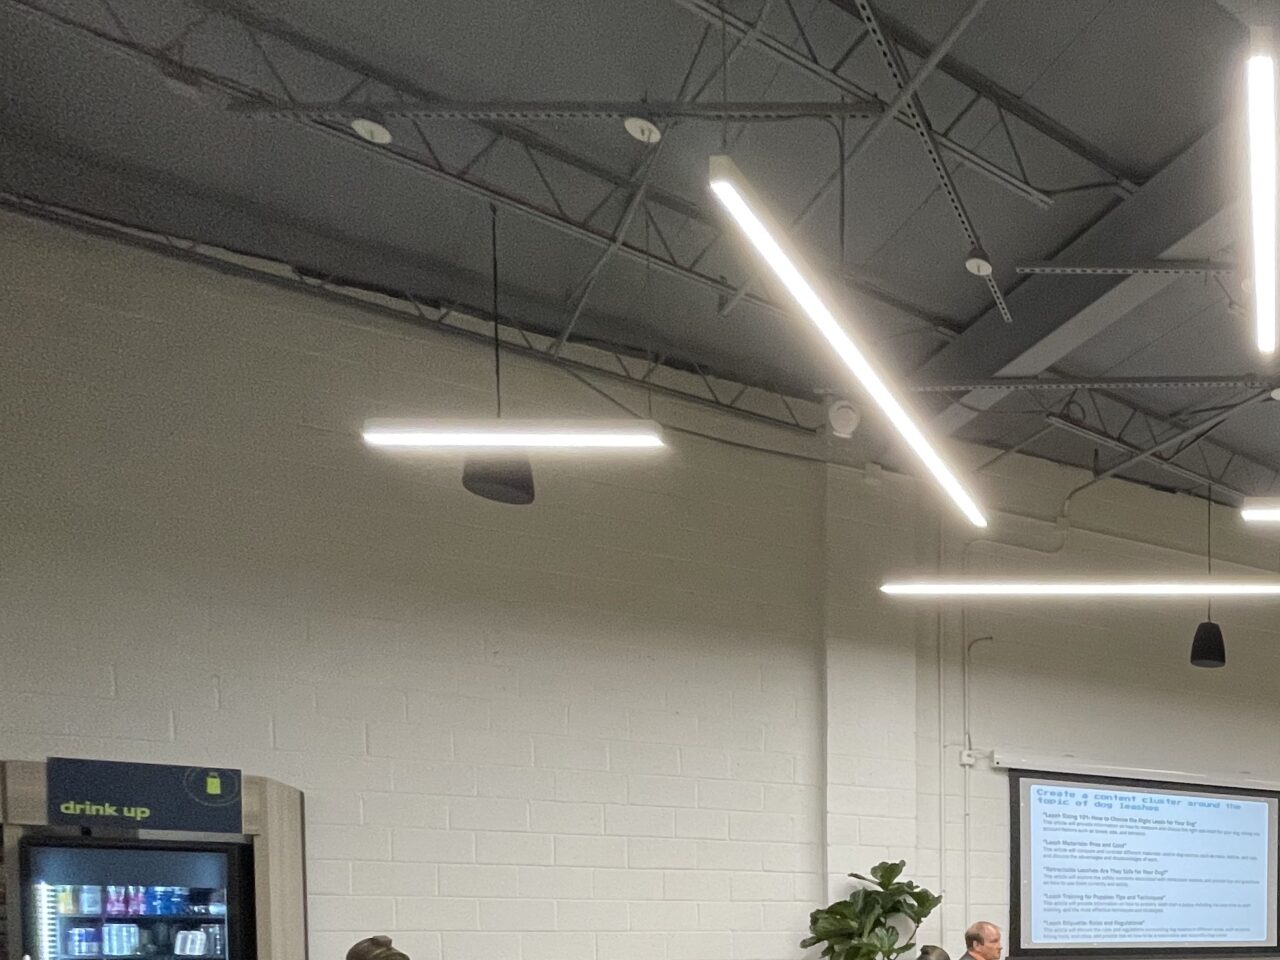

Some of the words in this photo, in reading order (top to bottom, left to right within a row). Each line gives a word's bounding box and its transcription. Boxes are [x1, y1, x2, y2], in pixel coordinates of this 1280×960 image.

[1036, 788, 1076, 798] Create
[1094, 794, 1136, 802] content
[1142, 796, 1182, 805] cluster
[1188, 801, 1221, 809] around
[1037, 797, 1069, 806] topic
[1094, 801, 1113, 809] dog
[1120, 803, 1160, 811] leashes
[59, 801, 119, 817] drink
[123, 806, 151, 821] up
